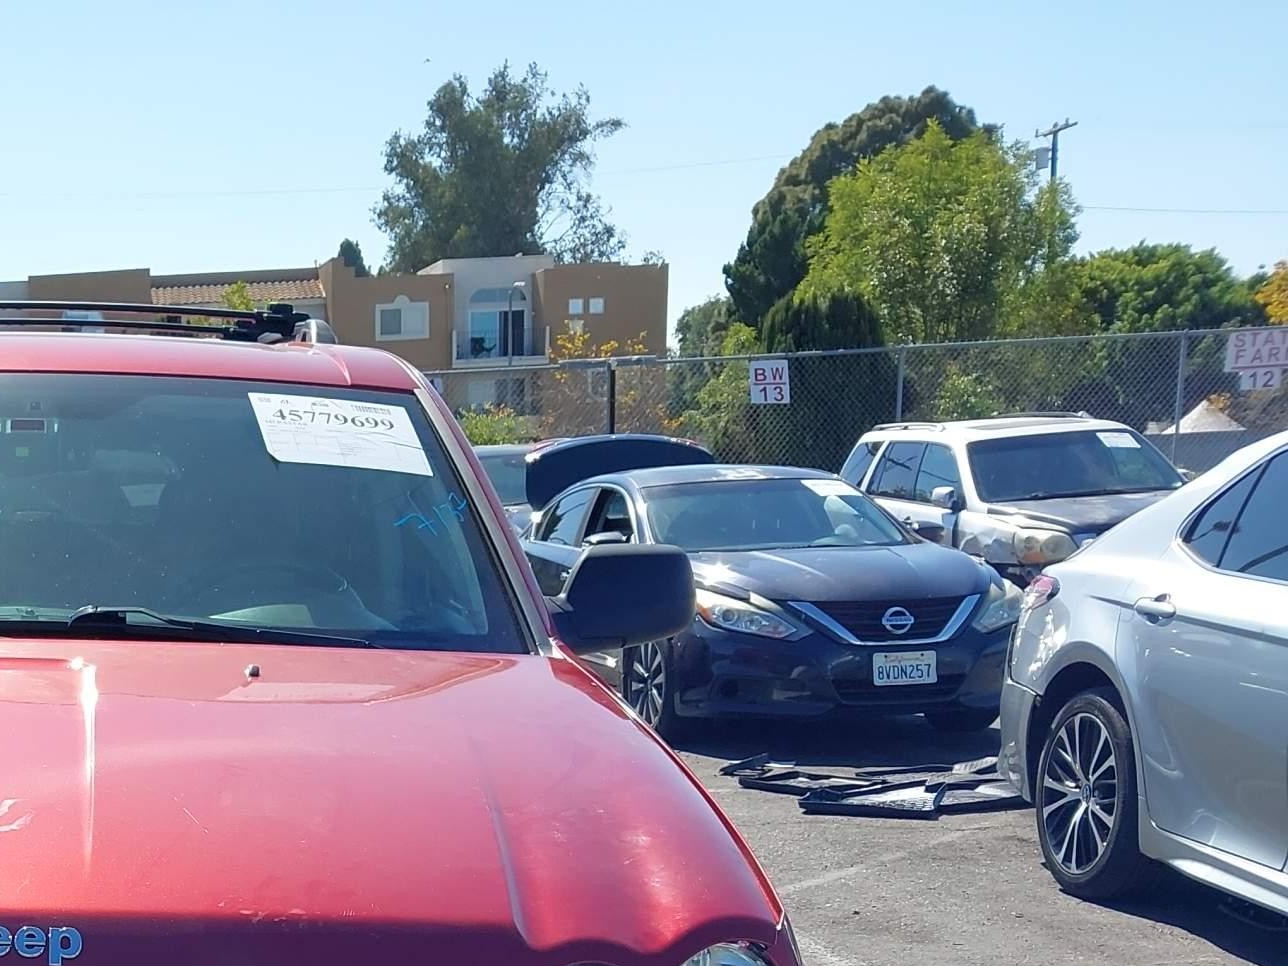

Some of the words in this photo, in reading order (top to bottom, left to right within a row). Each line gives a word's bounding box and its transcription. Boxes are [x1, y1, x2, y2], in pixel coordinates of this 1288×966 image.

[754, 367, 784, 382] BW
[1249, 370, 1274, 388] 12
[759, 386, 784, 402] 13
[272, 408, 394, 431] 45779699
[877, 663, 931, 680] 8VDN257
